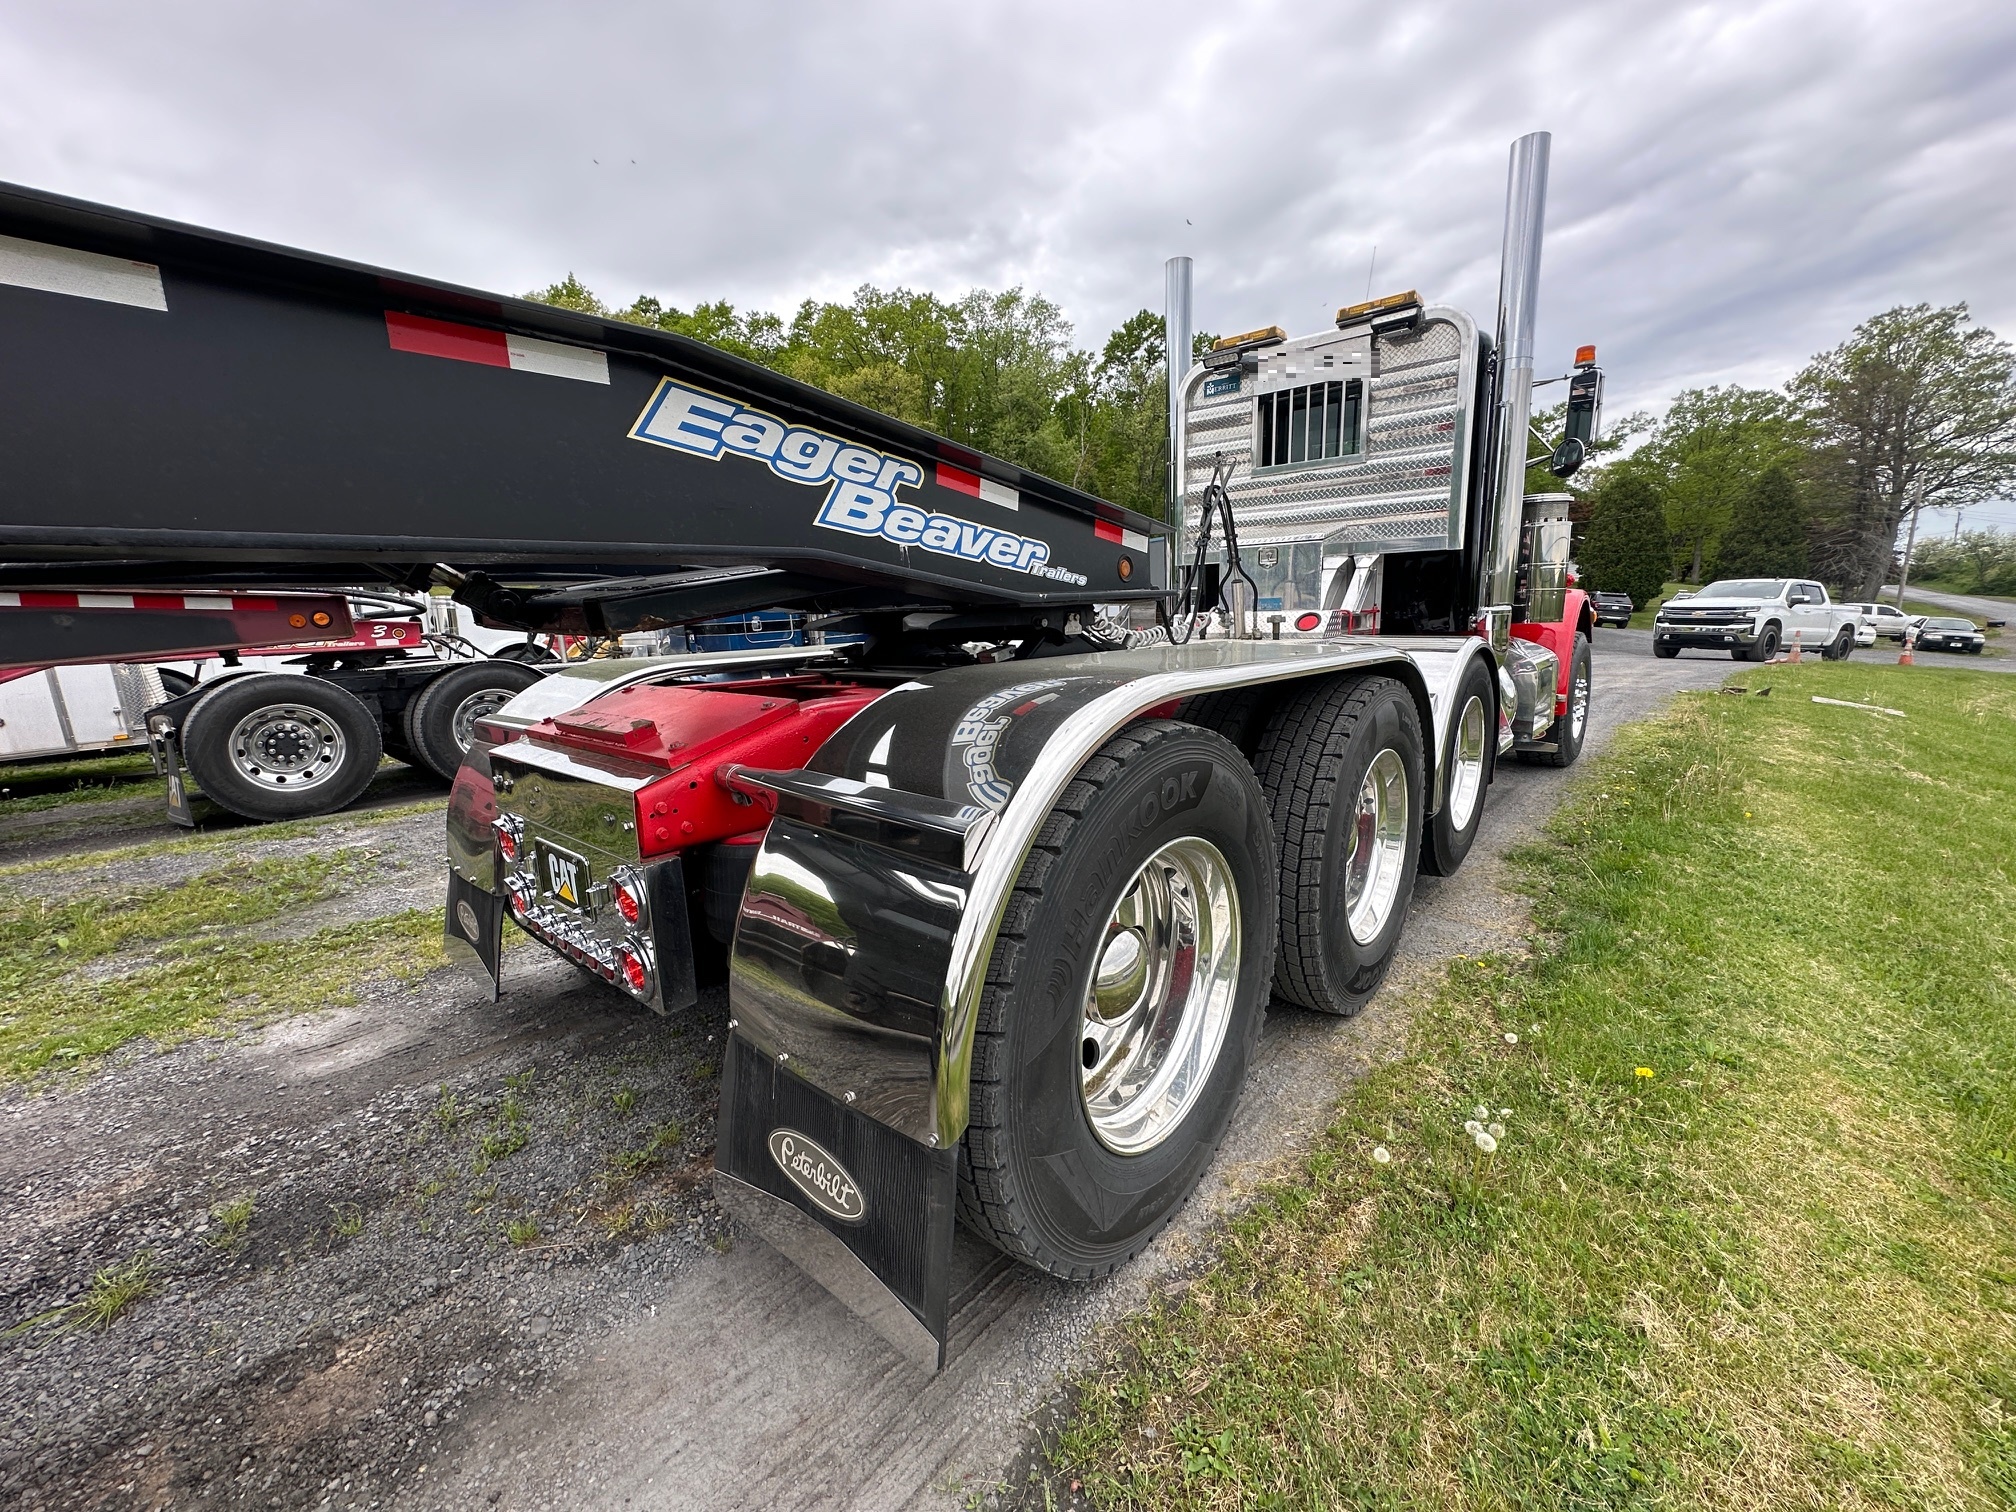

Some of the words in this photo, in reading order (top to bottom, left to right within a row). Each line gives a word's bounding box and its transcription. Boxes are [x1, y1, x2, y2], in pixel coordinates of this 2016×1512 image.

[634, 379, 923, 487] Eager
[820, 480, 1049, 569] Beaver
[1031, 561, 1088, 587] Trailers
[371, 625, 387, 638] 3
[548, 853, 578, 905] CAT
[781, 1136, 855, 1210] Peterbilt
